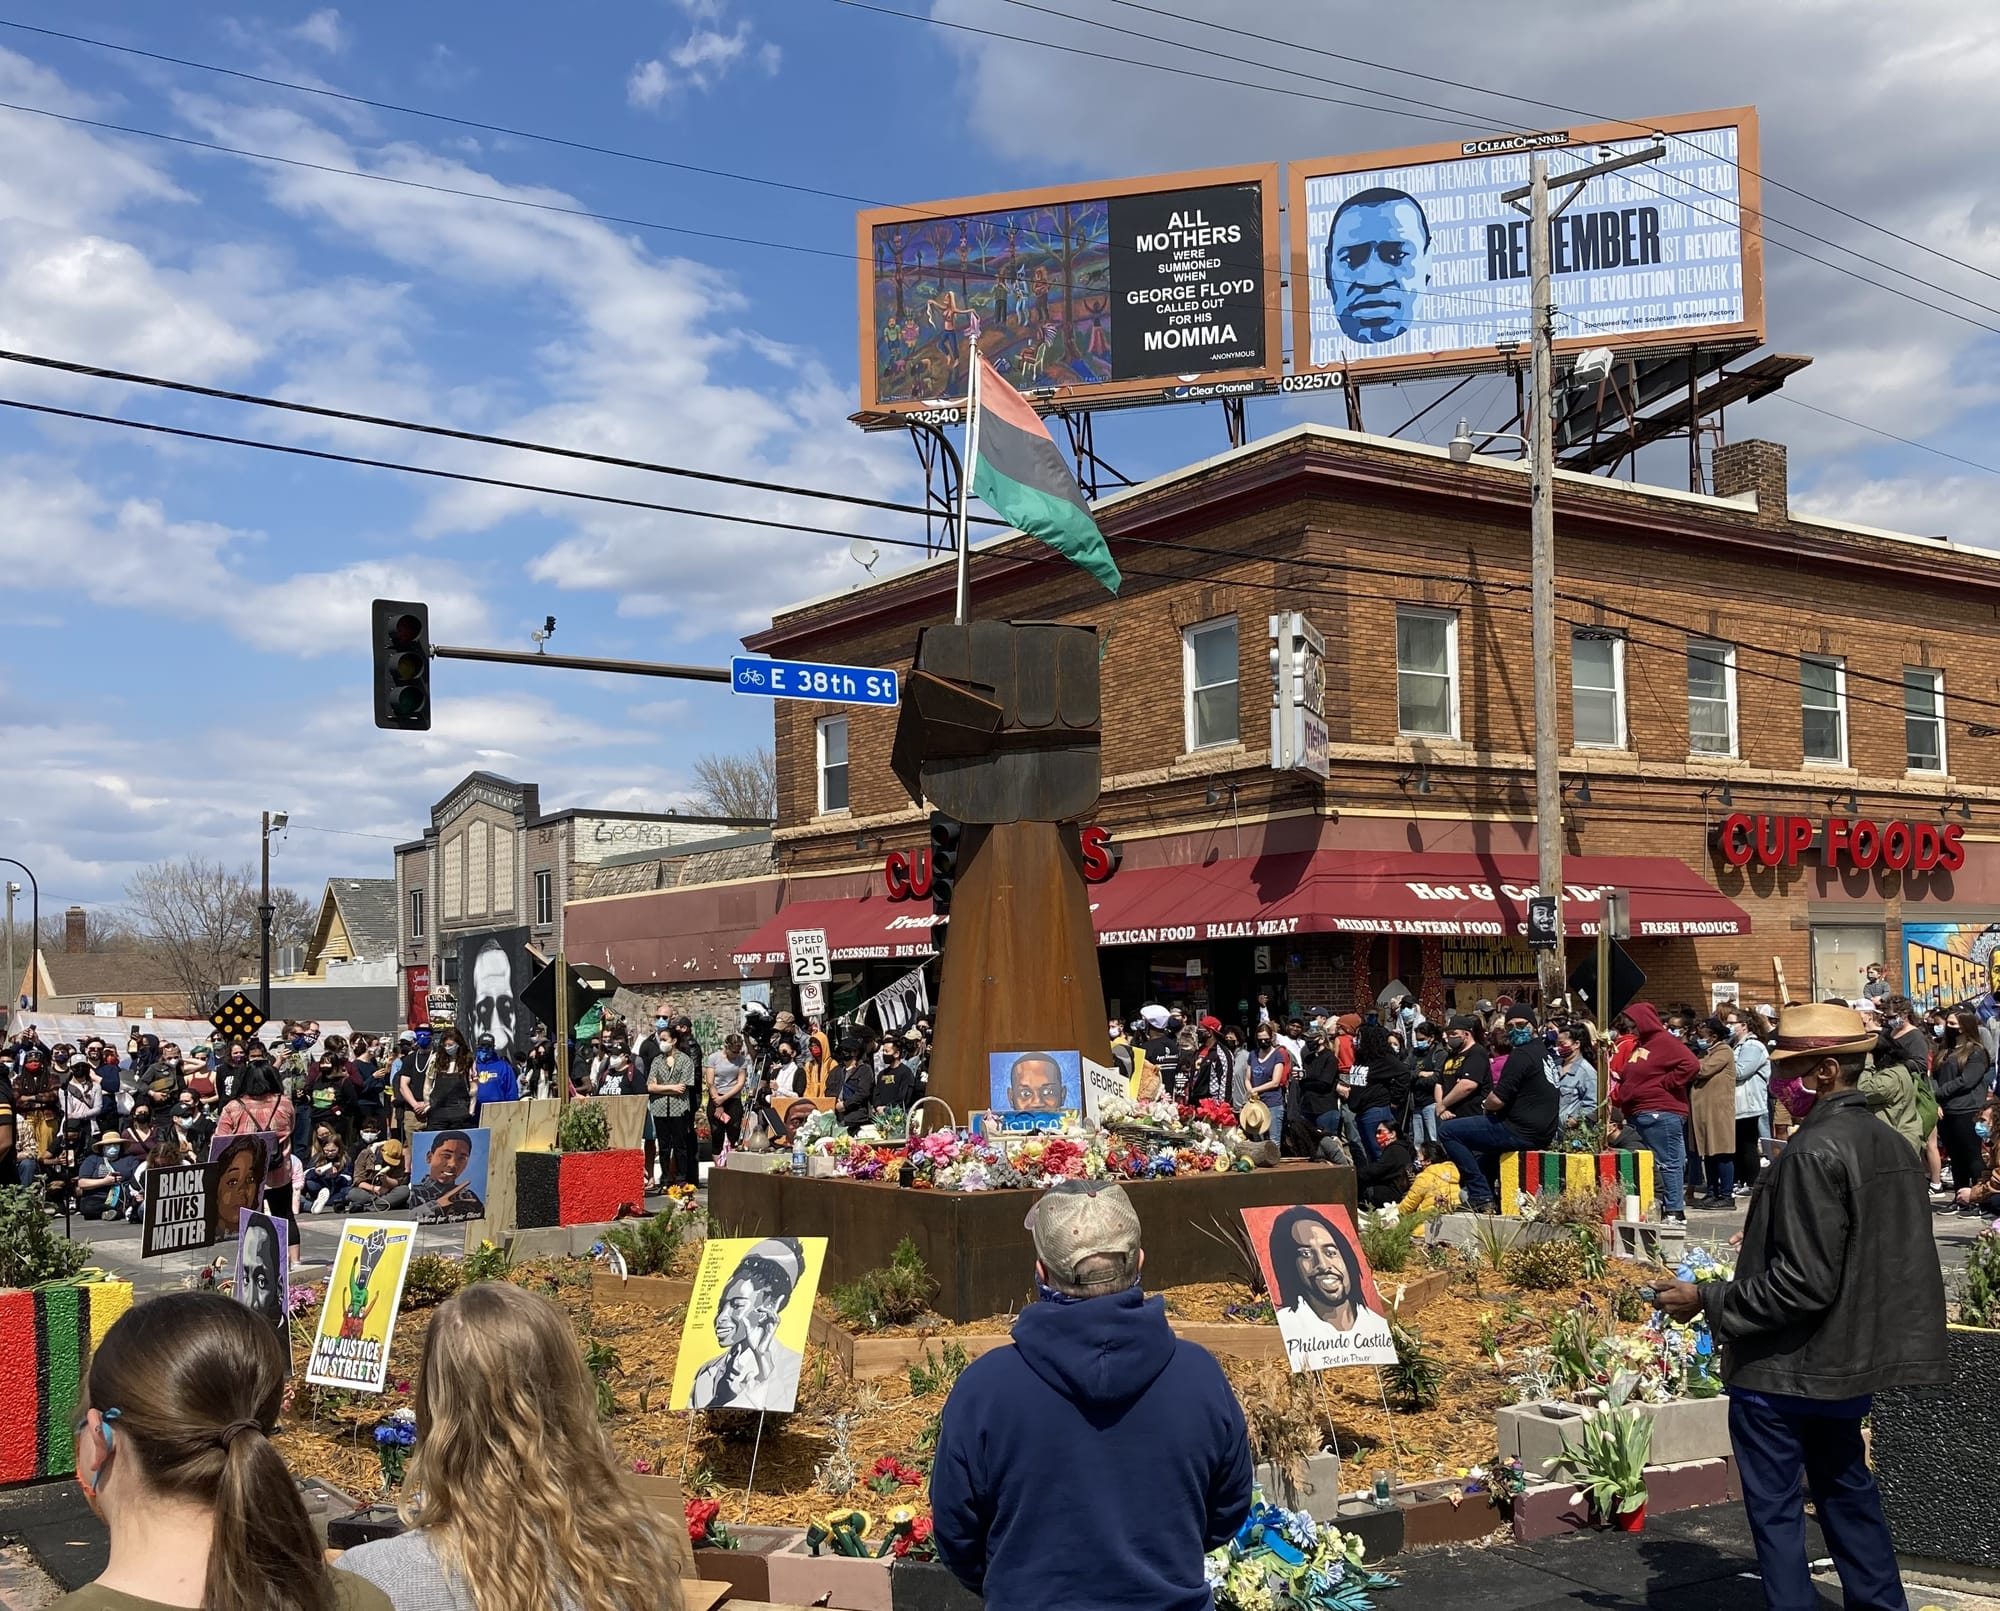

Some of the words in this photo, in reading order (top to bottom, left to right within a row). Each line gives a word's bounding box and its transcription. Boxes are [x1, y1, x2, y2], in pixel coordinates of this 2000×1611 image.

[1439, 161, 1488, 191] REMARK
[1652, 132, 1724, 165] EPARATION
[1608, 173, 1659, 201] REJOIN
[1663, 169, 1694, 196] REAP
[1698, 165, 1732, 193] READ
[1167, 209, 1209, 229] ALL
[1136, 225, 1241, 252] MOTHERS
[1173, 249, 1205, 261] WERE
[1432, 257, 1487, 288] REWRITE
[1685, 229, 1737, 260] REVOKE
[1158, 258, 1221, 273] SUMMONED
[1174, 271, 1206, 282] WHEN
[1127, 285, 1196, 304] GEORGE
[1201, 279, 1254, 298] FLOYD
[1423, 288, 1492, 320] REPARATION
[1498, 284, 1531, 314] RECA
[1551, 278, 1586, 306] REMIT
[1590, 270, 1675, 302] REVOLUTION
[1679, 264, 1728, 293] REMARK
[1156, 301, 1199, 313] CALLED
[1202, 298, 1224, 309] OUT
[1169, 314, 1191, 325] FOR
[1194, 312, 1212, 323] HIS
[1584, 320, 1620, 329] Sponsored
[1621, 318, 1632, 326] by:
[1644, 314, 1677, 324] Sculpture
[1683, 311, 1707, 321] Gallery
[1709, 309, 1735, 318] Factory
[1144, 324, 1238, 351] MOMMA
[1412, 322, 1457, 353] REJOIN
[1463, 320, 1491, 348] REAP
[1209, 350, 1255, 360] -ANONYMOUS
[1189, 385, 1214, 396] Clear
[1216, 382, 1254, 394] Channel
[1282, 372, 1342, 392] 032570
[771, 668, 786, 689] E
[797, 670, 856, 695] 38th
[866, 676, 892, 698] St
[1723, 813, 1813, 866] CUP
[1827, 818, 1966, 871] FOODS
[886, 848, 932, 899] CU
[1405, 883, 1469, 901] Hot
[1469, 883, 1496, 901] &
[885, 915, 938, 930] Fresh
[1207, 921, 1253, 938] HALAL
[1257, 917, 1299, 935] MEAT
[1332, 918, 1392, 933] MIDDLE
[1394, 919, 1461, 934] EASTERN
[1464, 921, 1502, 935] FOOD
[1640, 922, 1681, 934] FRESH
[1682, 921, 1739, 934] PRODUCE
[791, 935, 824, 945] SPEED
[1099, 929, 1156, 945] MEXICAN
[1159, 926, 1196, 941] FOOD
[733, 952, 761, 965] STAMPS
[765, 952, 785, 963] KEYS
[796, 945, 821, 956] LIMIT
[831, 946, 889, 960] ACCESSORIES
[896, 944, 914, 957] BUS
[795, 957, 826, 976] 25
[1443, 951, 1467, 975] BEING
[1469, 951, 1494, 975] BLACK
[1908, 940, 1985, 1012] GEORGE
[1089, 1070, 1124, 1098] GEORGE
[159, 1169, 204, 1198] BLACK
[161, 1195, 199, 1223] LIVES
[151, 1220, 206, 1250] MATTER
[320, 1337, 335, 1355] NO
[335, 1338, 380, 1361] JUSTICE
[1286, 1333, 1350, 1355] Philando
[1353, 1333, 1393, 1349] Castile
[313, 1355, 328, 1374] NO
[329, 1358, 381, 1382] STREETS
[1321, 1355, 1341, 1365] Rest
[1341, 1354, 1350, 1363] in
[1350, 1353, 1371, 1363] Power
